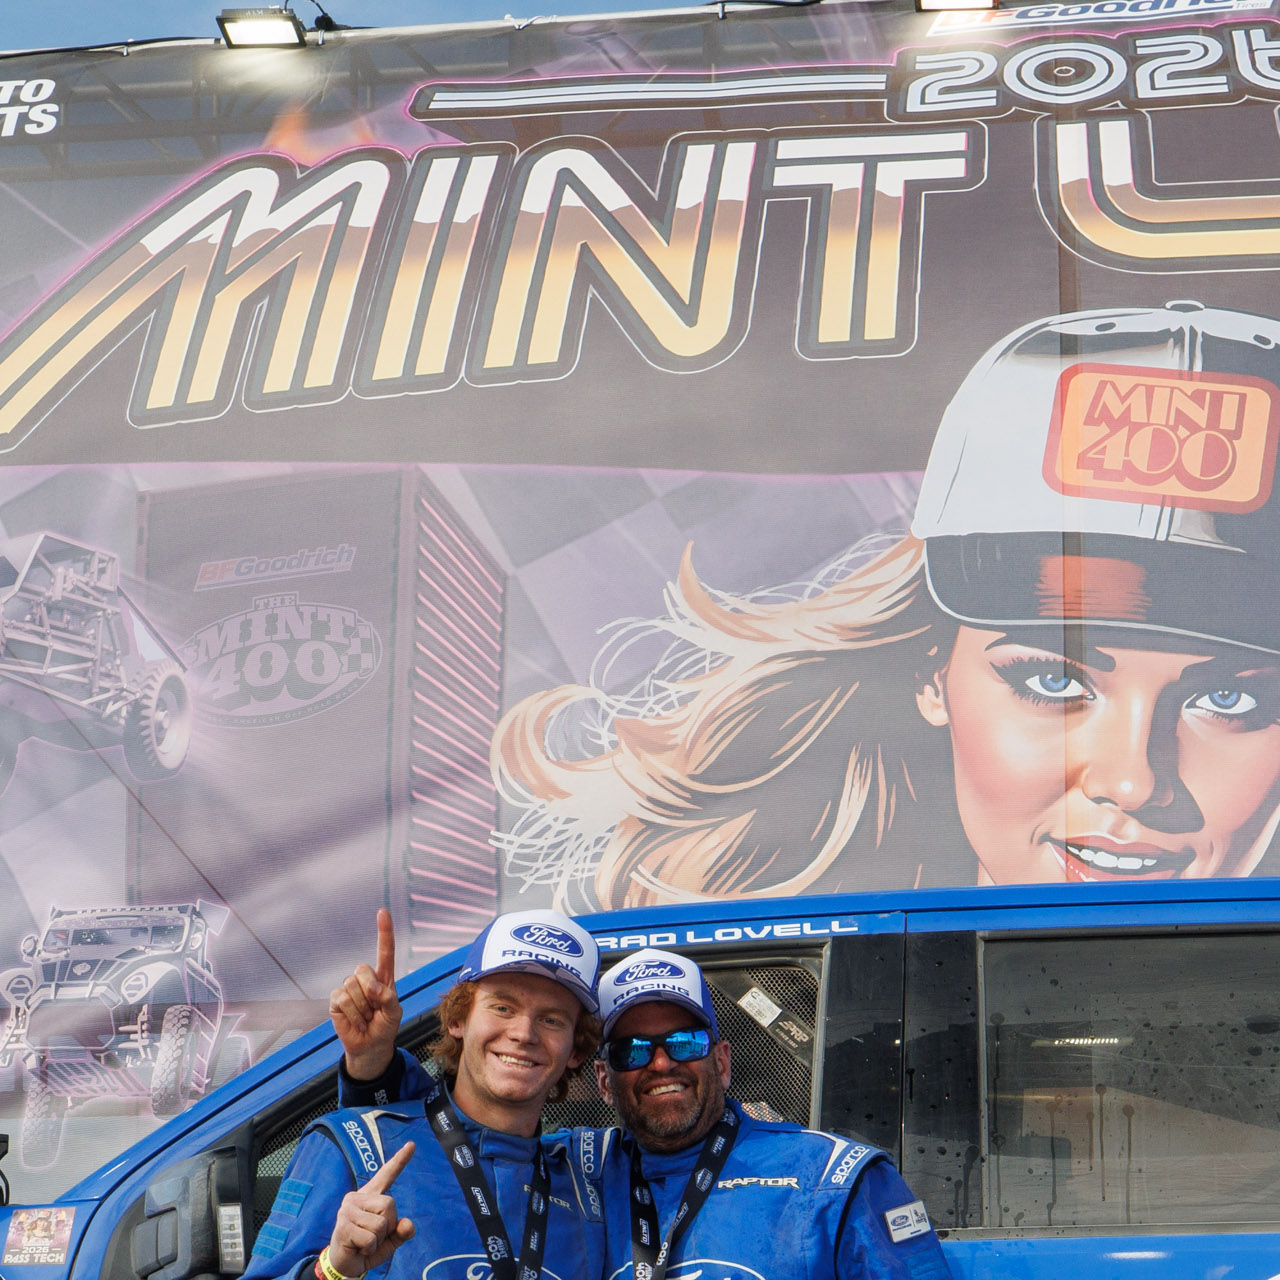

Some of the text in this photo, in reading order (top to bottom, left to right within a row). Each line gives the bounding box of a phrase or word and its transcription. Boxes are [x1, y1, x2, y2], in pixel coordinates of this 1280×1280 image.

[1078, 423, 1238, 492] 400
[200, 544, 356, 582] BFGoodrich
[256, 595, 296, 609] THE
[194, 604, 358, 659] MINT
[209, 641, 344, 701] 400
[522, 923, 571, 952] Ford
[594, 920, 859, 949] RAD LOVELL
[501, 949, 583, 979] RACING
[625, 960, 673, 980] Ford
[613, 983, 691, 1005] RACING
[341, 1120, 379, 1173] sparco
[580, 1131, 595, 1174] sparco
[831, 1145, 870, 1185] sparco
[718, 1176, 801, 1190] RAPTOR
[472, 1187, 489, 1215] UNLTD
[4, 1253, 65, 1263] PASS TECH
[22, 1246, 49, 1254] 2026
[487, 1236, 501, 1261] 400
[656, 1241, 669, 1266] 400
